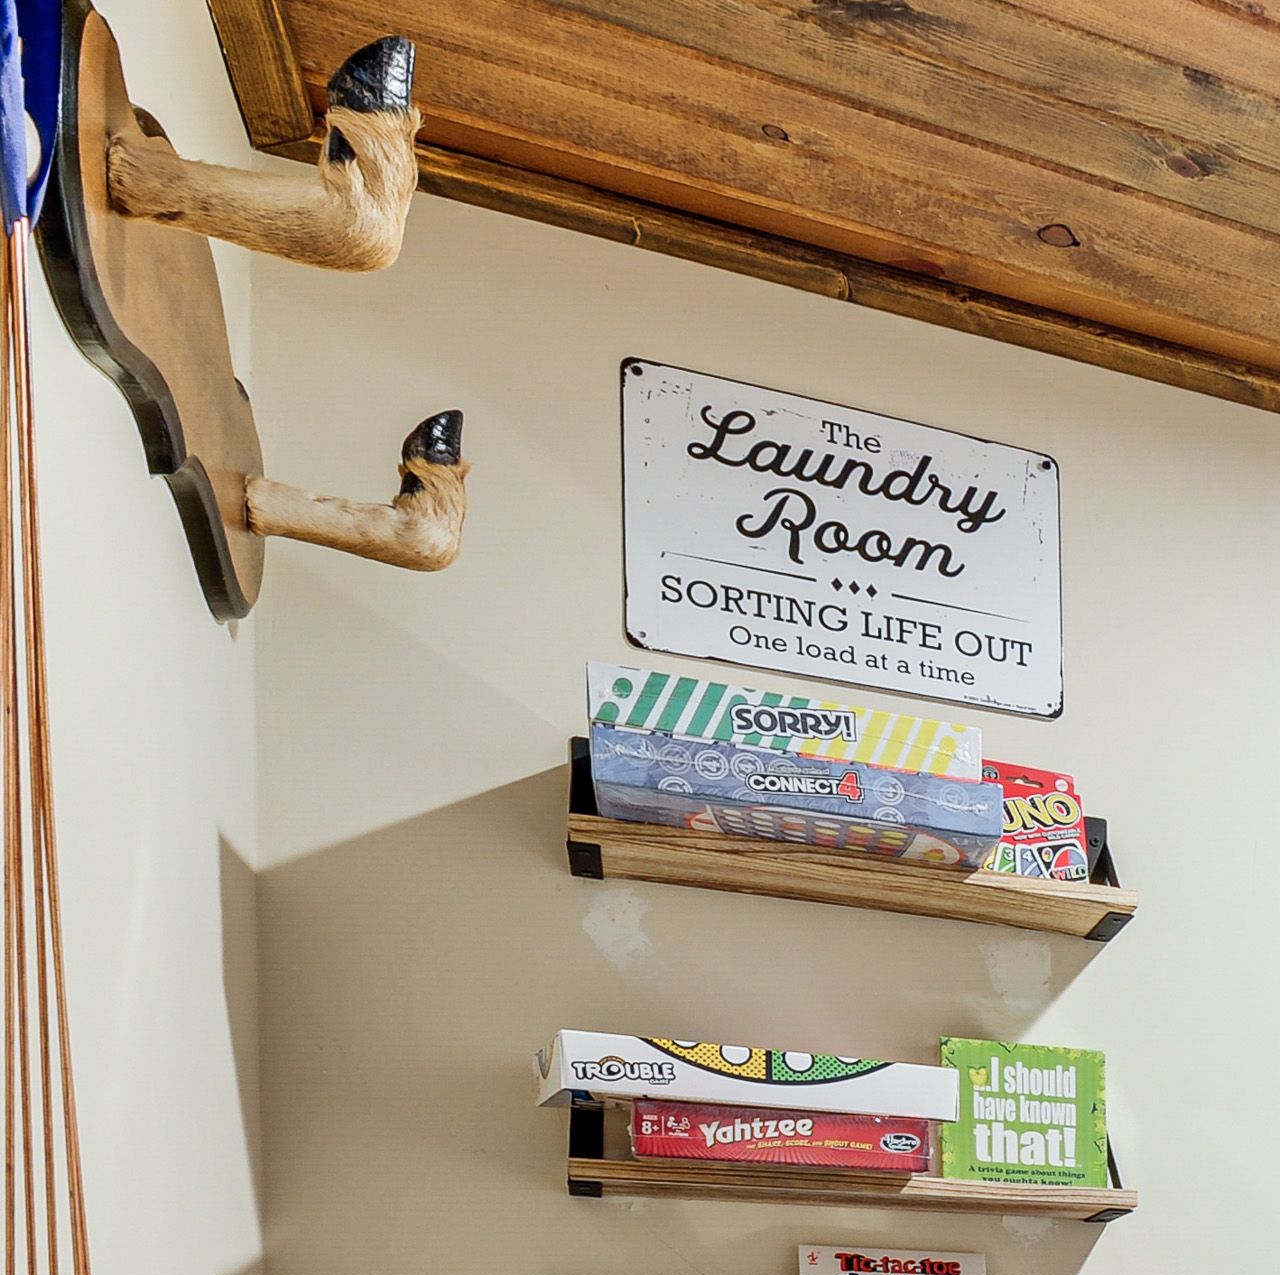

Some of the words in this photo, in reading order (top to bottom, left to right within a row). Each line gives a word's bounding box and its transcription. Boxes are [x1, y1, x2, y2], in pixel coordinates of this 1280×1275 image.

[820, 419, 882, 454] The
[686, 404, 1006, 534] Laundry
[735, 487, 966, 578] Room
[660, 574, 849, 632] SORTING
[861, 611, 942, 652] LIFE
[954, 630, 1033, 668] OUT
[729, 624, 788, 654] One
[796, 635, 856, 666] load
[864, 652, 890, 671] at
[896, 658, 912, 675] a
[919, 659, 976, 686] time
[734, 706, 853, 739] SORRY!
[1003, 792, 1081, 833] UNO
[1004, 848, 1014, 859] 3
[1022, 851, 1033, 862] 4
[1052, 864, 1088, 880] WILD
[571, 1058, 676, 1082] TROUBLE
[1003, 1061, 1077, 1099] should
[973, 1091, 1017, 1123] have
[1020, 1094, 1077, 1127] known
[642, 1120, 660, 1135] 8+
[699, 1118, 814, 1148] Yahtzee
[973, 1121, 1077, 1168] that!
[978, 1166, 1004, 1174] trivia
[1005, 1168, 1029, 1176] game
[1030, 1169, 1057, 1177] about
[1058, 1171, 1086, 1179] things
[834, 1252, 961, 1275] Tic-tac-toe
